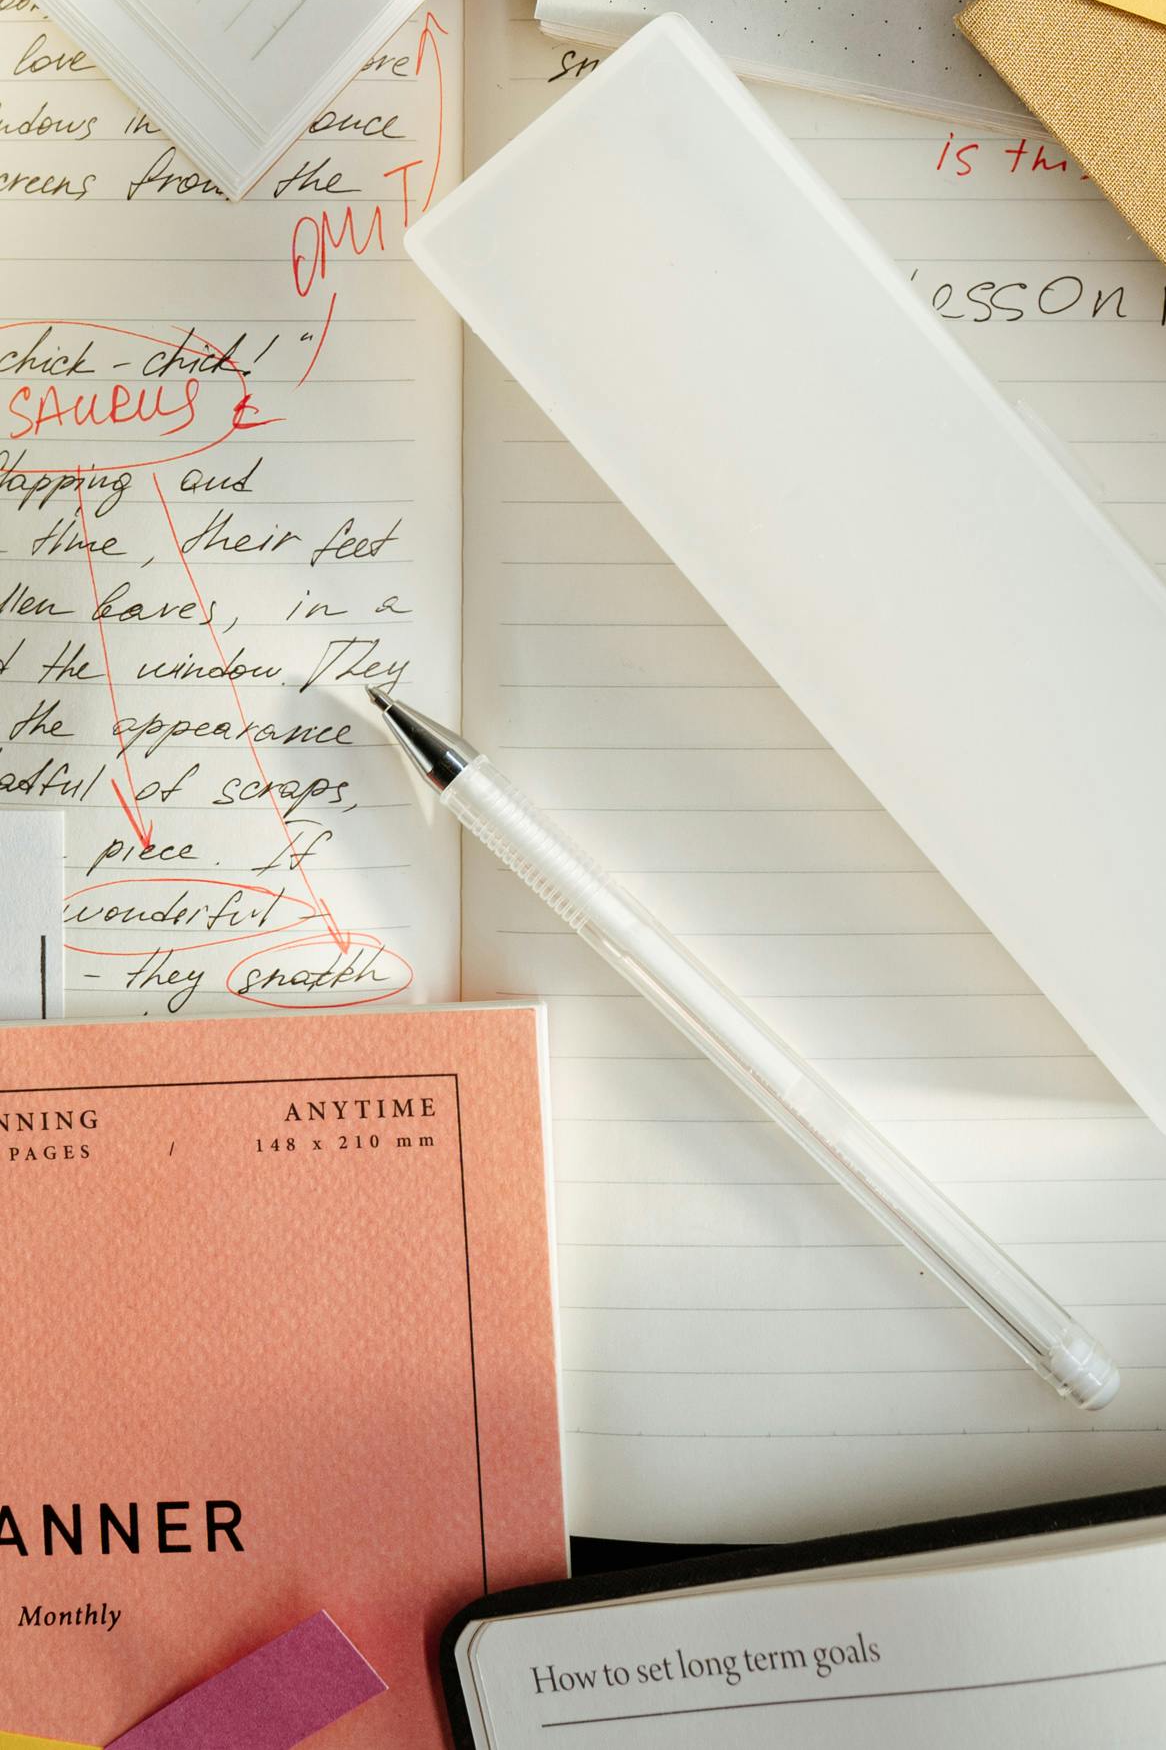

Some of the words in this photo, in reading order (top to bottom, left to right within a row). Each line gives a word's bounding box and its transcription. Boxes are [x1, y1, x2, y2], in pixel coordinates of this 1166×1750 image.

[273, 156, 362, 199] the
[910, 268, 1127, 323] esson
[179, 457, 263, 494] and
[285, 589, 348, 621] in
[375, 595, 413, 614] a
[37, 639, 107, 684] the
[9, 699, 75, 741] the
[134, 763, 200, 803] of
[125, 947, 206, 1014] they
[284, 1097, 437, 1122] ANYTIME
[8, 1144, 91, 1162] PAGES
[255, 1138, 297, 1153] 148
[338, 1134, 380, 1150] 210
[396, 1134, 435, 1148] mm
[0, 1500, 245, 1557] ANNER
[18, 1603, 122, 1632] Monthly
[530, 1665, 598, 1695] How
[602, 1663, 631, 1686] to
[636, 1657, 674, 1684] set
[676, 1649, 742, 1686] long
[742, 1646, 808, 1674] term
[813, 1632, 882, 1678] goals
